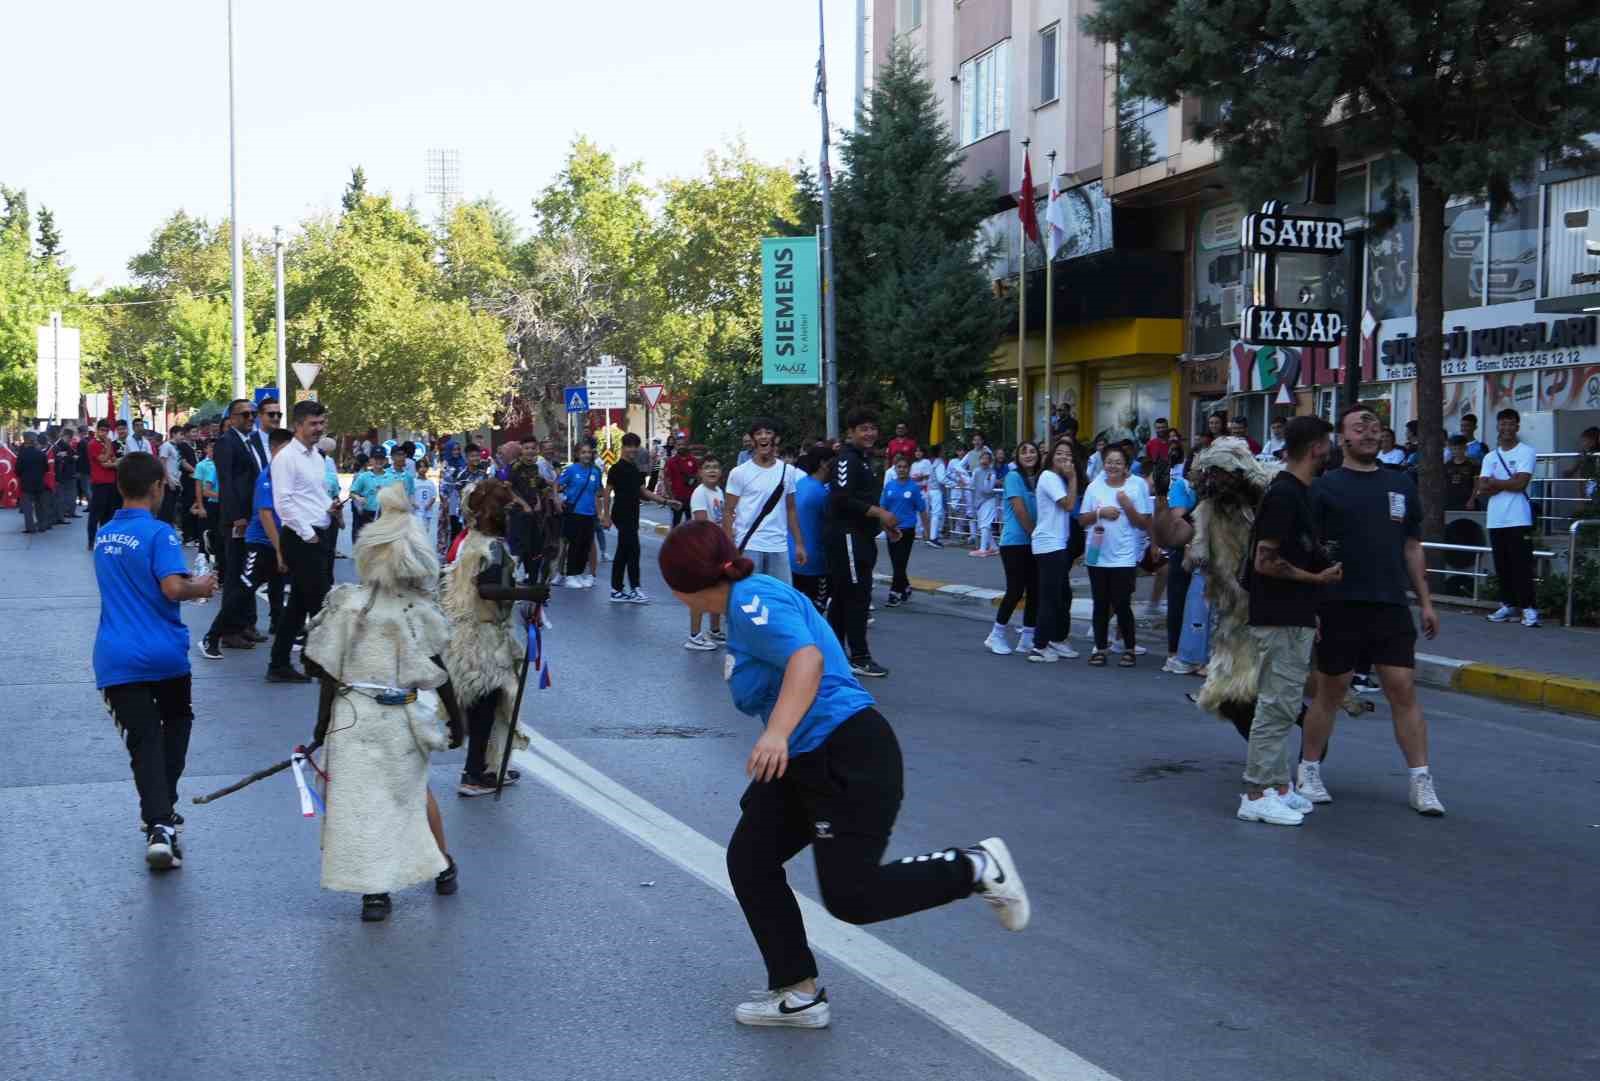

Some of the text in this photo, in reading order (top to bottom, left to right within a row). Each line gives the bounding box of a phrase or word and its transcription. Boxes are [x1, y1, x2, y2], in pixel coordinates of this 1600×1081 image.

[1259, 218, 1345, 249] SATIR
[775, 248, 794, 357] SIEMENS
[1259, 310, 1342, 342] KASAP
[1502, 355, 1527, 368] 0552
[1529, 353, 1548, 366] 245
[1551, 352, 1563, 364] 12
[1566, 350, 1581, 363] 12
